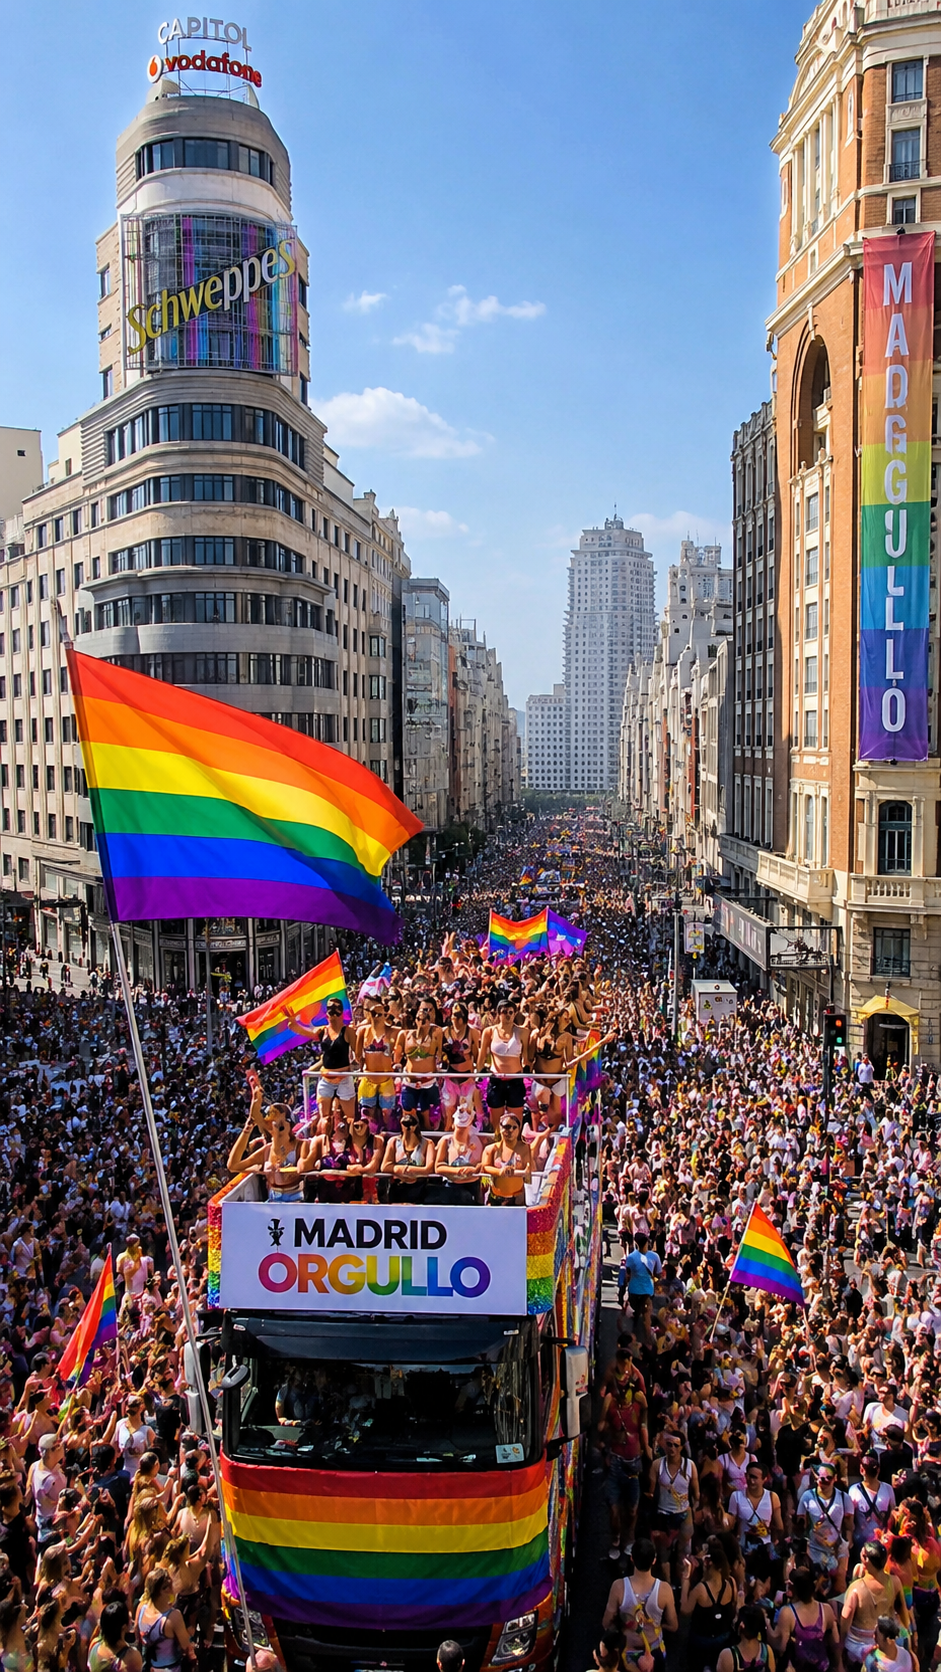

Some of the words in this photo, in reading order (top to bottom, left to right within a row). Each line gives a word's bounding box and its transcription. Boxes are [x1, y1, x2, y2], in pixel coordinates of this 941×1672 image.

[158, 17, 252, 51] CAPITOL
[165, 50, 262, 88] vodafone
[126, 239, 296, 356] Schweppes
[294, 1217, 447, 1250] MADRID
[258, 1252, 491, 1298] ORGULLO
